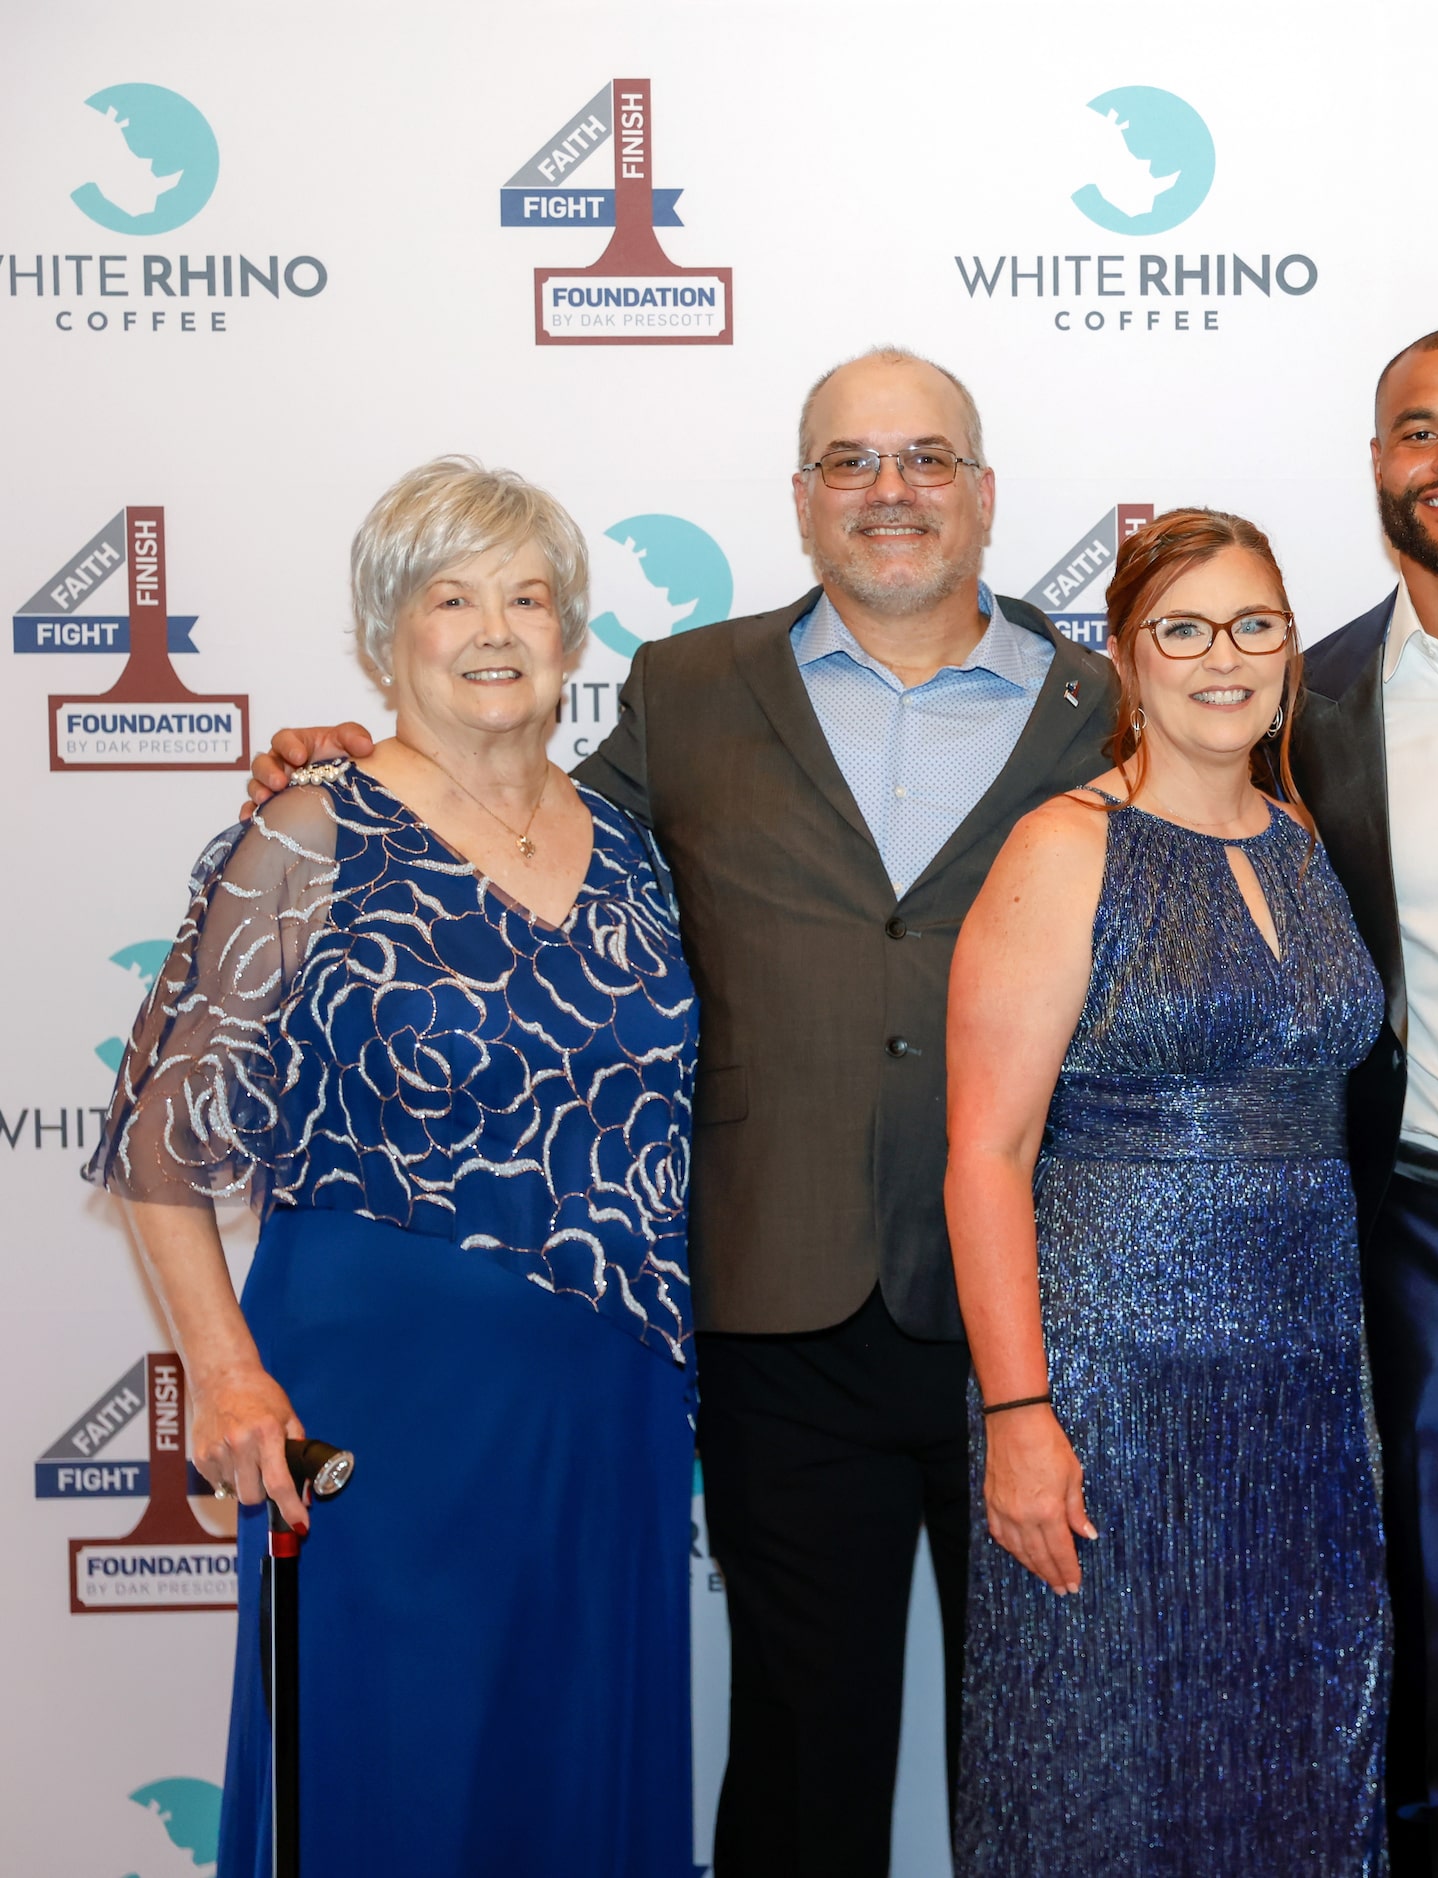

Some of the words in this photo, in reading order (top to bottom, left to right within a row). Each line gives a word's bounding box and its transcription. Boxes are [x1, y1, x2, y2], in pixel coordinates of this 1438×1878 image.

[622, 94, 644, 178] FINISH
[538, 115, 606, 181] FAITH
[524, 197, 604, 218] FIGHT
[0, 255, 128, 296] HITE
[144, 254, 327, 298] RHINO
[954, 256, 1125, 297] WHITE
[1140, 254, 1318, 297] RHINO
[553, 288, 715, 307] FOUNDATION
[56, 311, 226, 331] COFFEE
[553, 314, 572, 326] BY
[581, 314, 615, 326] DAK
[624, 314, 713, 326] PRESCOTT
[1055, 311, 1219, 330] COFFEE
[135, 520, 158, 605] FINISH
[1043, 540, 1110, 606] FAITH
[51, 542, 119, 609] FAITH
[37, 624, 118, 645] FIGHT
[68, 714, 232, 733] FOUNDATION
[67, 741, 87, 753] BY
[96, 741, 130, 753] DAK
[139, 740, 231, 753] PRESCOTT
[155, 1366, 179, 1450] FINISH
[72, 1388, 141, 1455] FAITH
[58, 1468, 139, 1491] FIGHT
[87, 1583, 106, 1595] BY
[115, 1583, 150, 1595] DAK
[158, 1580, 237, 1595] PRESCOT
